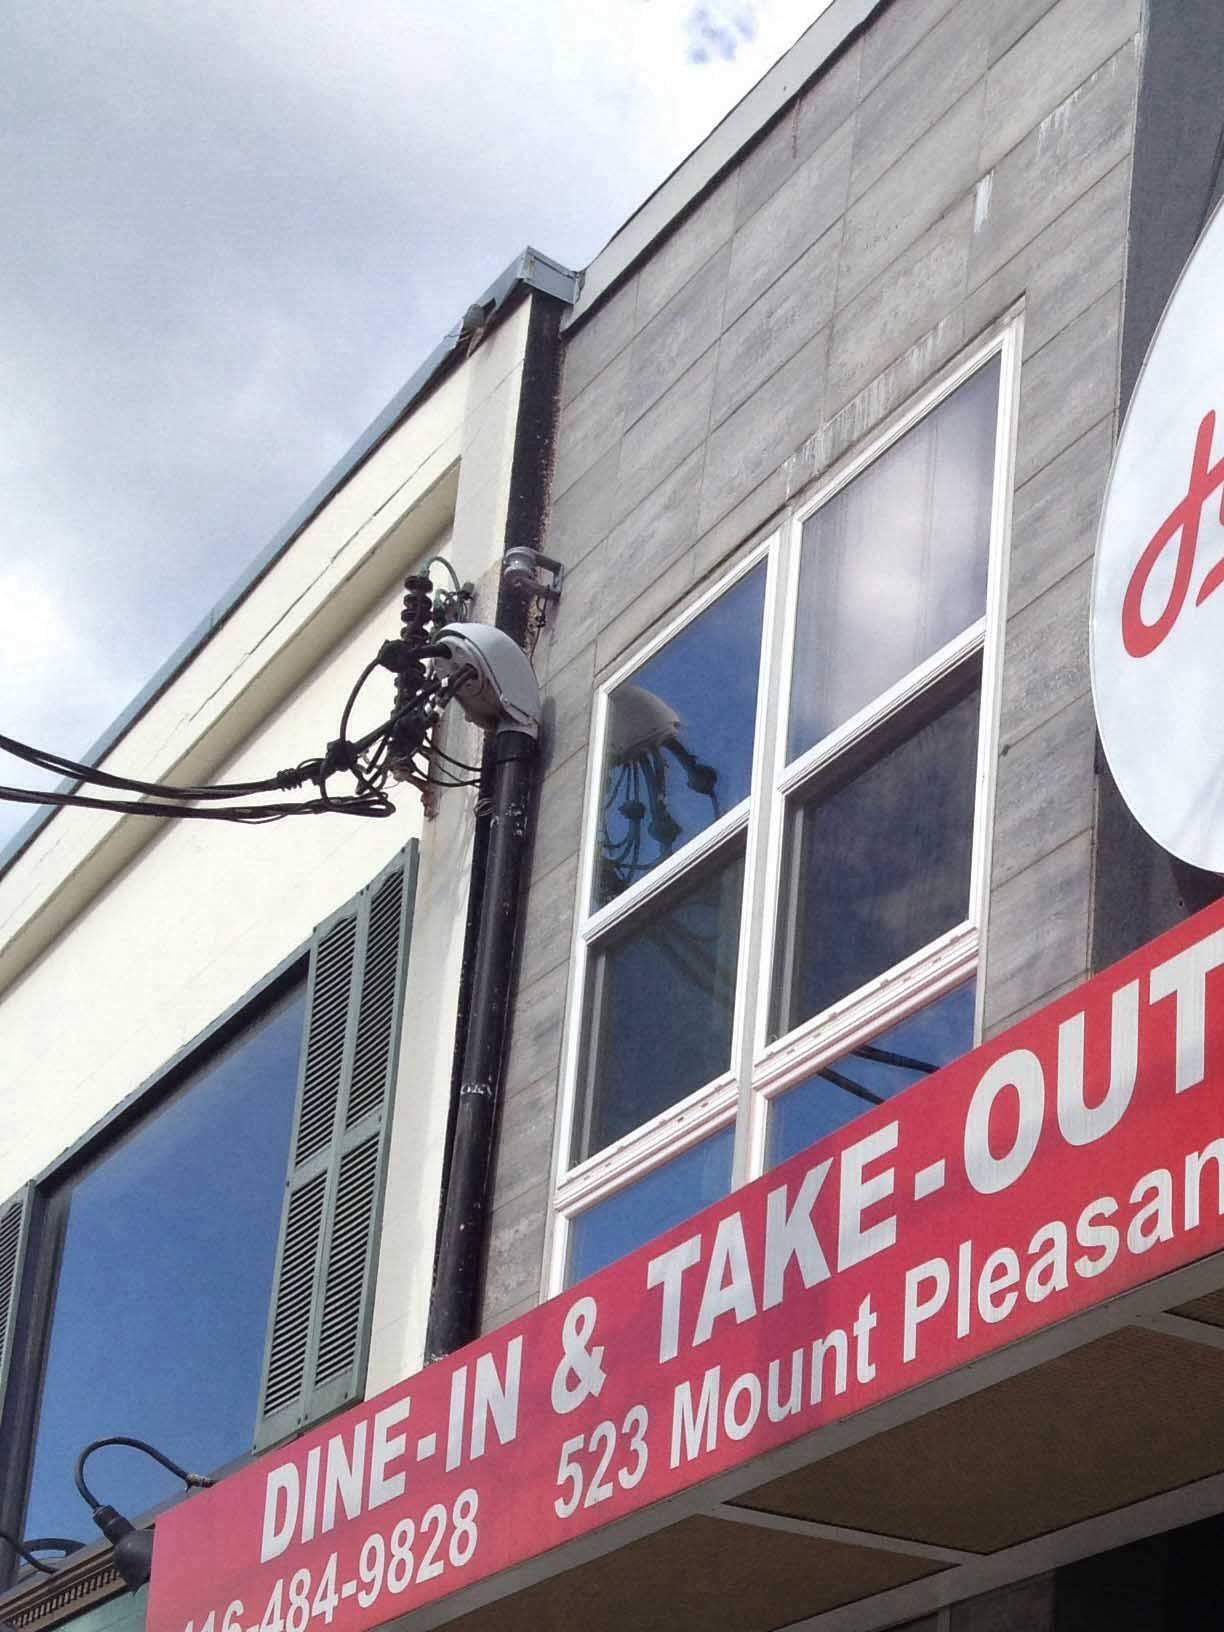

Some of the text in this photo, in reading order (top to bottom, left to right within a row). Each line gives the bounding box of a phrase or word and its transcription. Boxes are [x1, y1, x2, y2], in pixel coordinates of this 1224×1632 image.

[259, 1334, 524, 1564] DINE-IN
[550, 1296, 608, 1415] &
[553, 1404, 649, 1519] 523
[669, 1294, 878, 1470] Mount
